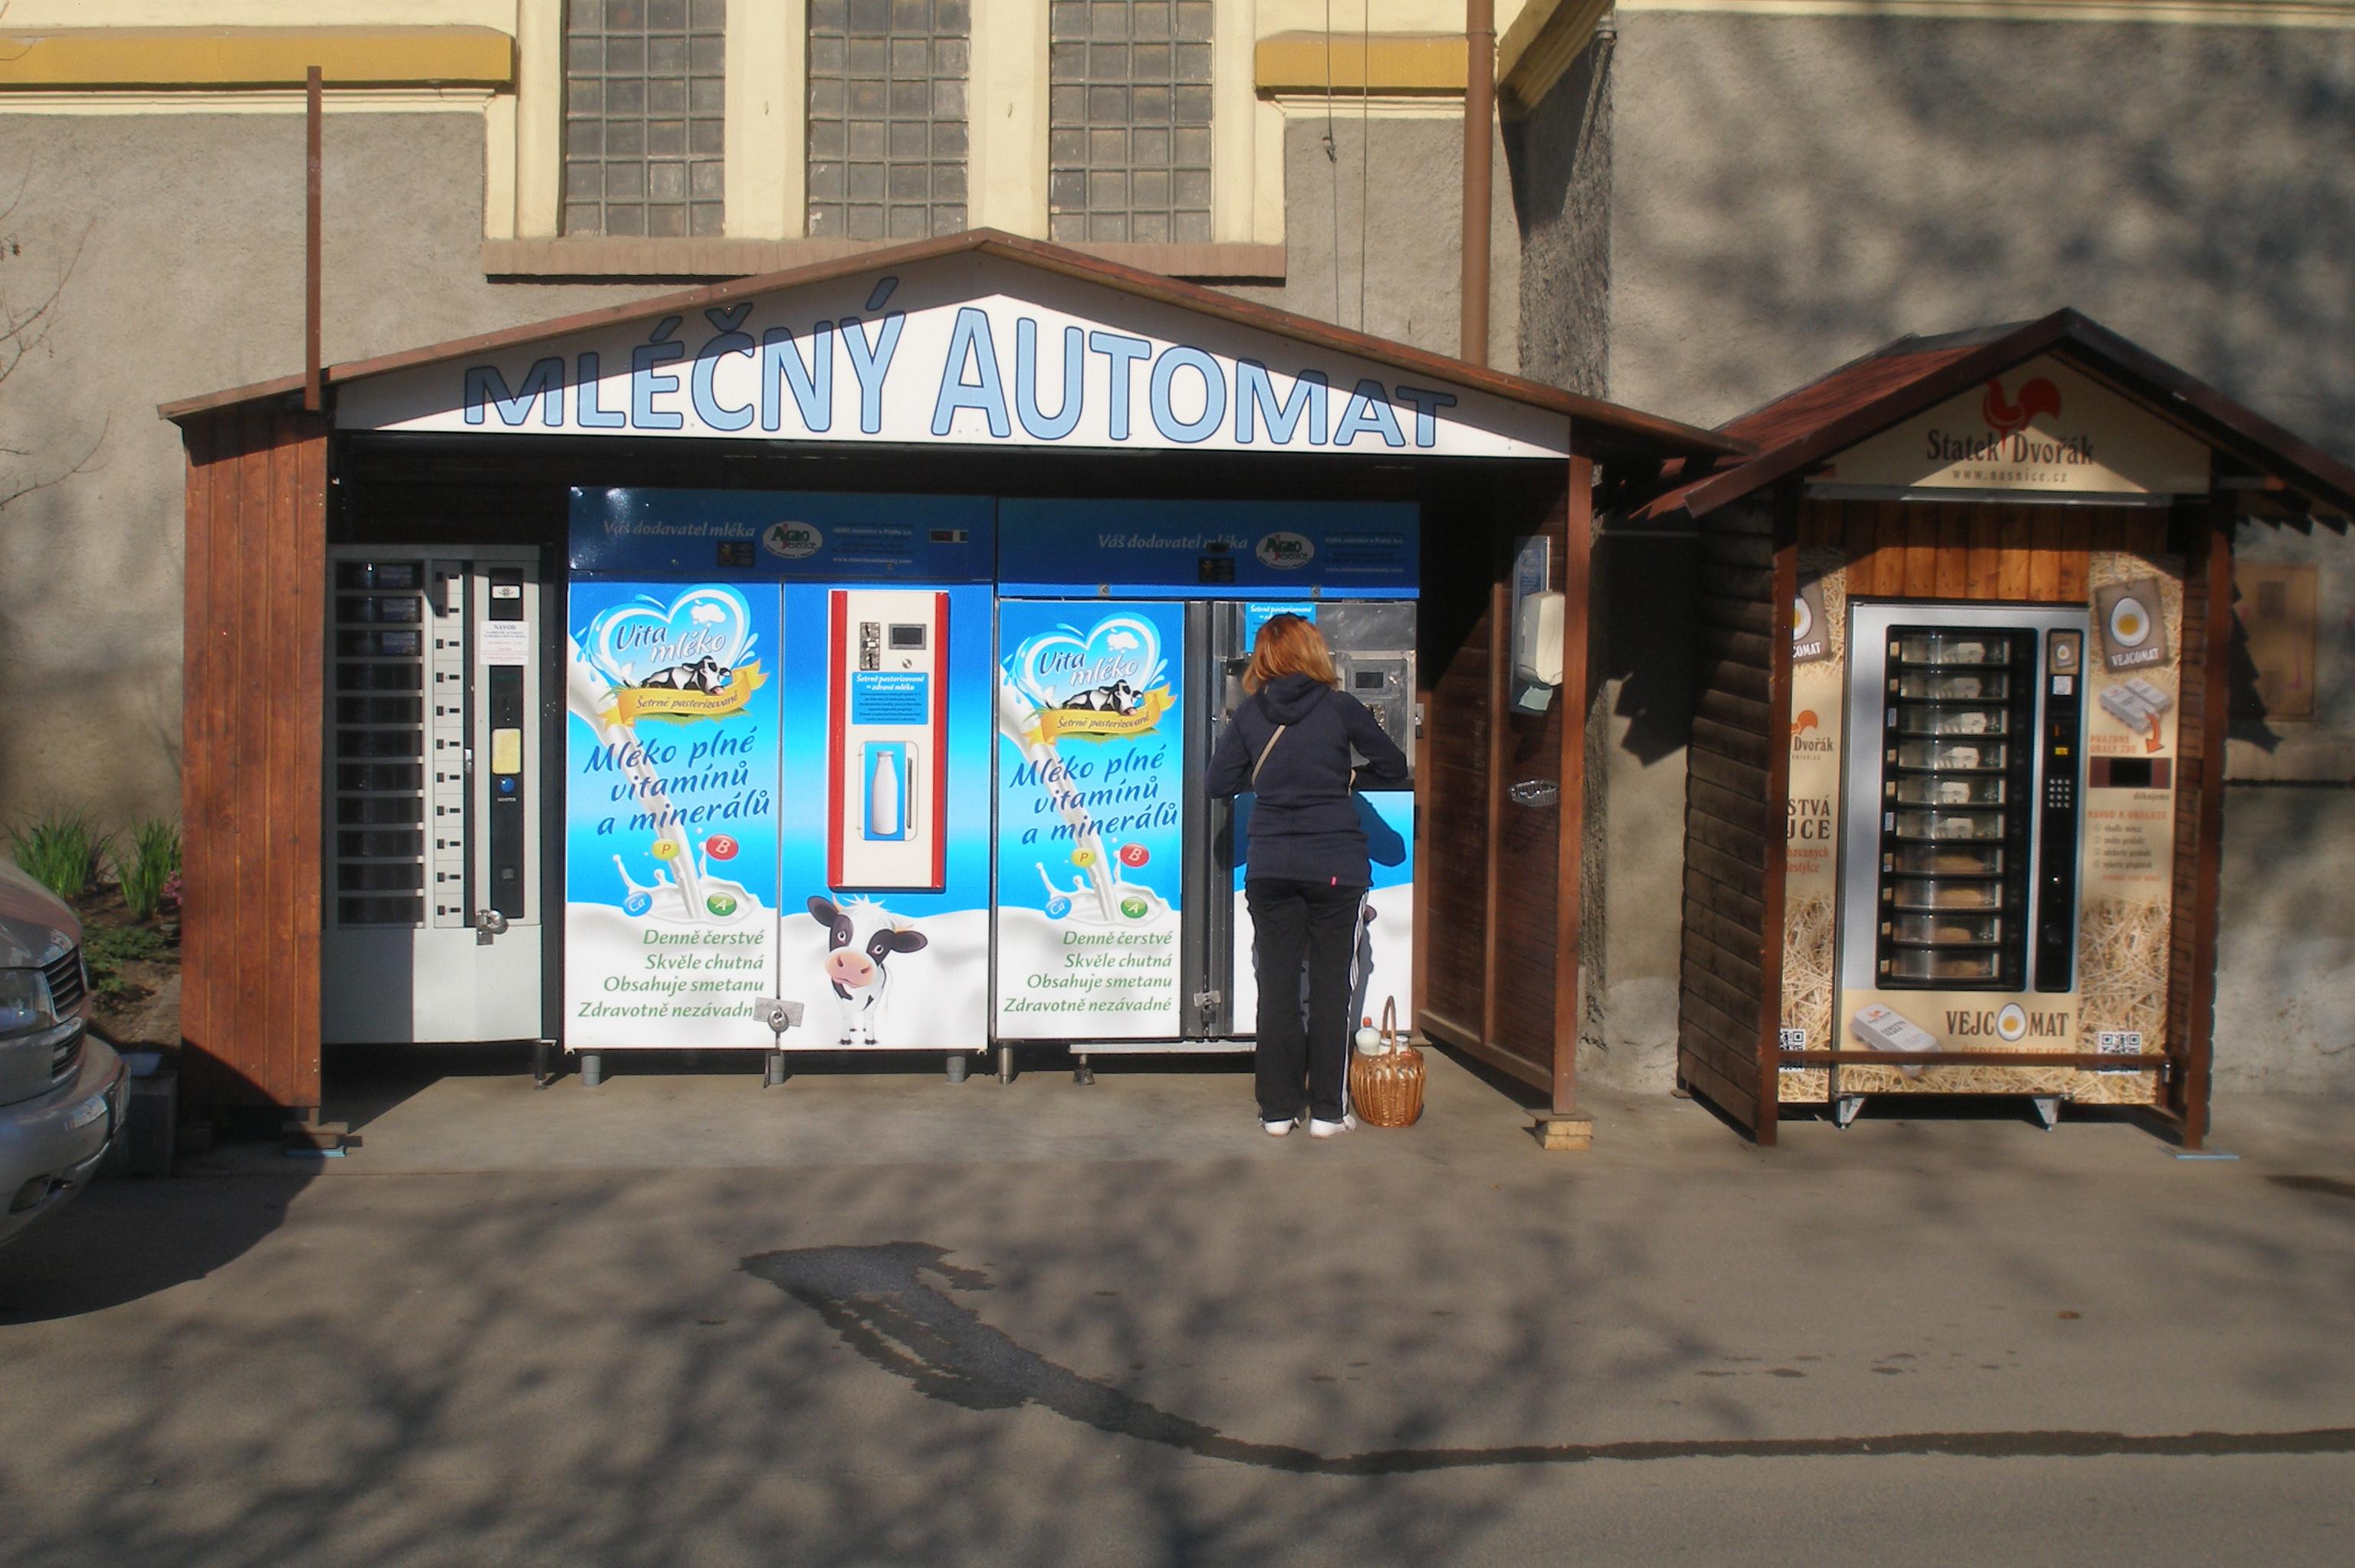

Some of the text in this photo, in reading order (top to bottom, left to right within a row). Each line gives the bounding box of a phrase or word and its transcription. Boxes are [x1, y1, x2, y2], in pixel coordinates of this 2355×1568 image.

[465, 276, 1458, 448] MLÉČNÝ AUTOMAT
[1926, 429, 2094, 465] Statek Dvořák
[603, 520, 755, 537] Váš dodavatel mléka
[1099, 533, 1125, 549] Váš
[1128, 533, 1200, 549] dodavatel
[616, 624, 666, 651] Vita
[651, 626, 726, 663] mléko
[1040, 651, 1085, 674] Vita
[1069, 654, 1139, 687] mléko
[636, 691, 739, 710] Šetrně pasterizované
[1057, 711, 1151, 729] Šetrně pasterizované
[583, 725, 758, 774] Mléko plné
[1794, 736, 1834, 752] Dvořák
[1009, 743, 1167, 789] Mléko plné
[610, 759, 749, 802] vitamínů
[1033, 774, 1161, 815] vitamínů
[596, 789, 770, 836] a minerálů
[1021, 802, 1178, 845] a minerálů
[661, 843, 671, 855] P
[714, 839, 731, 855] B
[1128, 847, 1141, 861] B
[1079, 851, 1089, 863] P
[628, 896, 645, 913] Ca
[714, 899, 728, 911] A
[1050, 900, 1066, 916] Ca
[1128, 902, 1140, 914] A
[642, 930, 764, 946] Denně čerstvé
[1063, 930, 1172, 946] Denně čerstvé
[644, 954, 764, 970] Skvěle chutná
[1064, 953, 1172, 969] Skvěle chutná
[603, 976, 764, 996] Obsahuje smetanu
[1026, 973, 1172, 992] Obsahuje smetanu
[578, 1001, 753, 1019] Zdravotně nezávadn
[1003, 996, 1171, 1012] Zdravotně nezávadné
